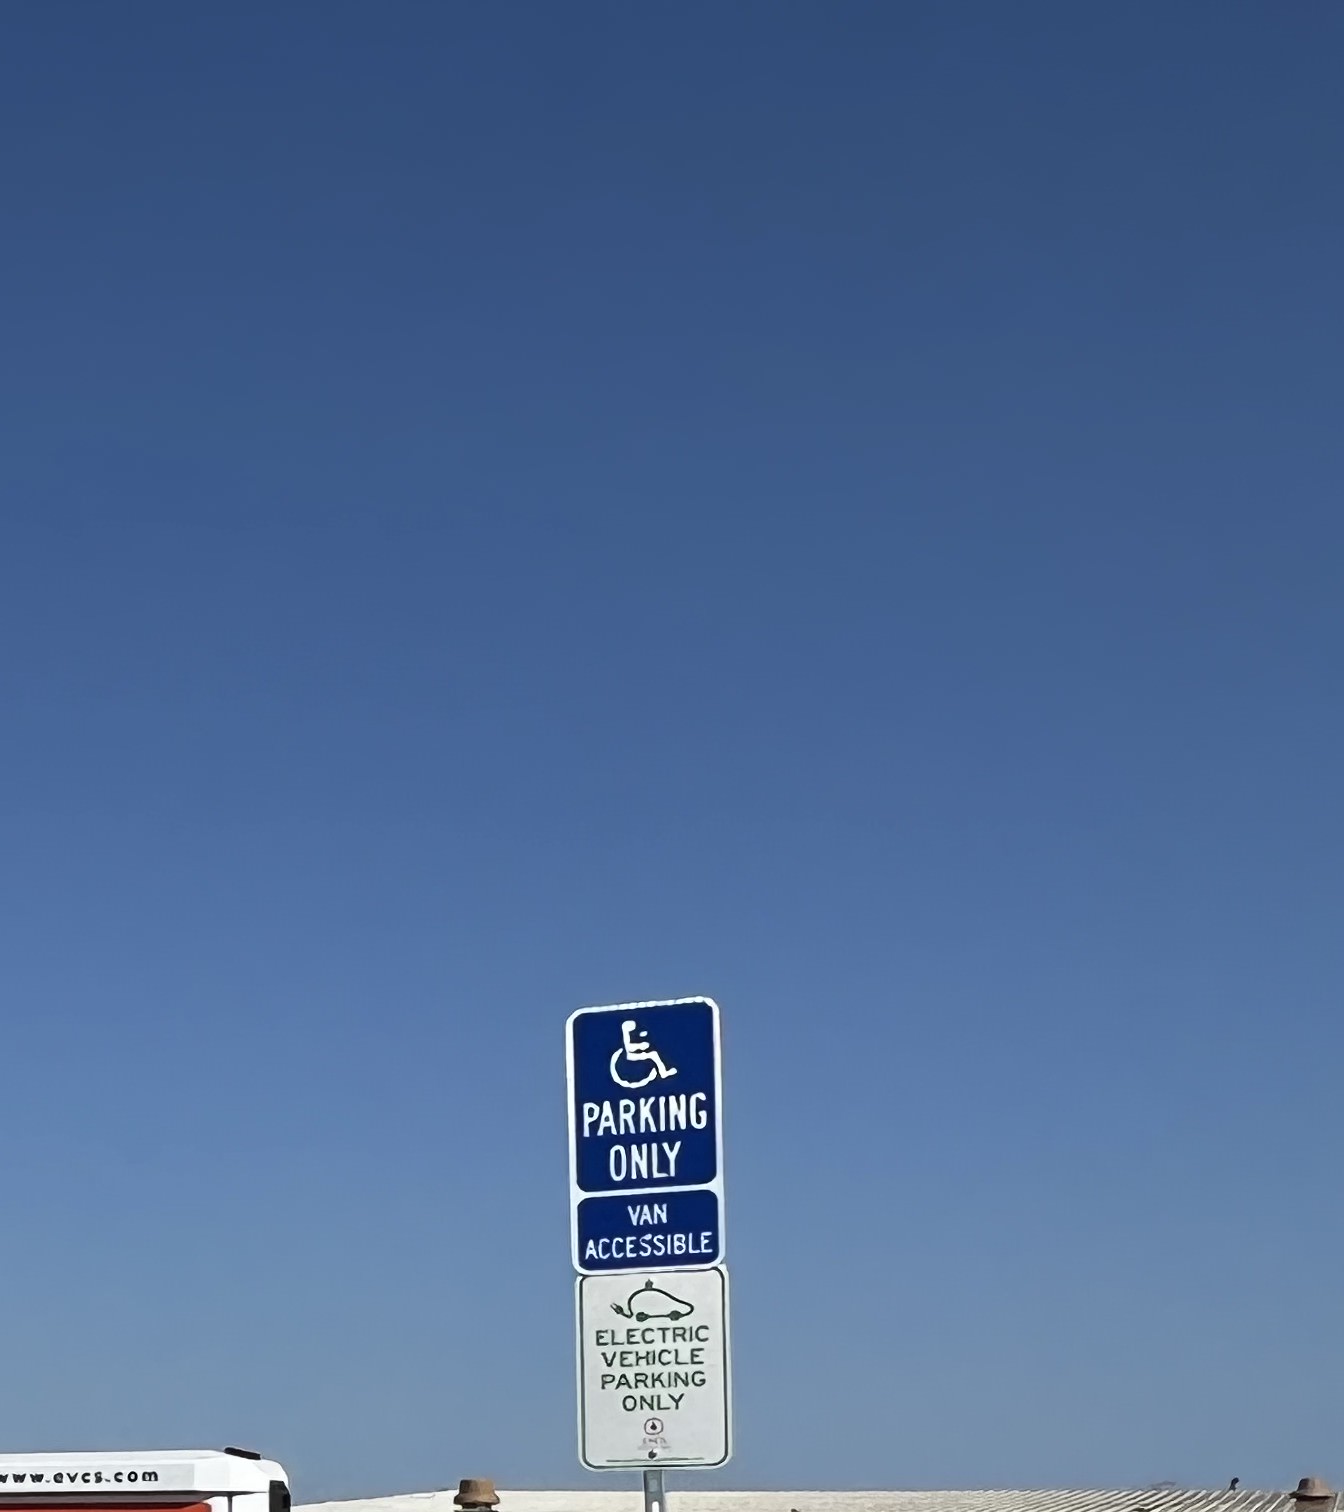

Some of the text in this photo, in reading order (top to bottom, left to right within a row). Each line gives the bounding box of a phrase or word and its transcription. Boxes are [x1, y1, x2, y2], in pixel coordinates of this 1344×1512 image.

[582, 1092, 708, 1138] PARKING
[609, 1141, 682, 1182] ONLY
[627, 1203, 668, 1227] VAN
[585, 1231, 713, 1260] ACCESSIBLE
[595, 1325, 710, 1347] ELECTRIC
[600, 1347, 705, 1368] VEHICLE
[600, 1371, 706, 1390] PARKING
[622, 1392, 685, 1412] ONLY
